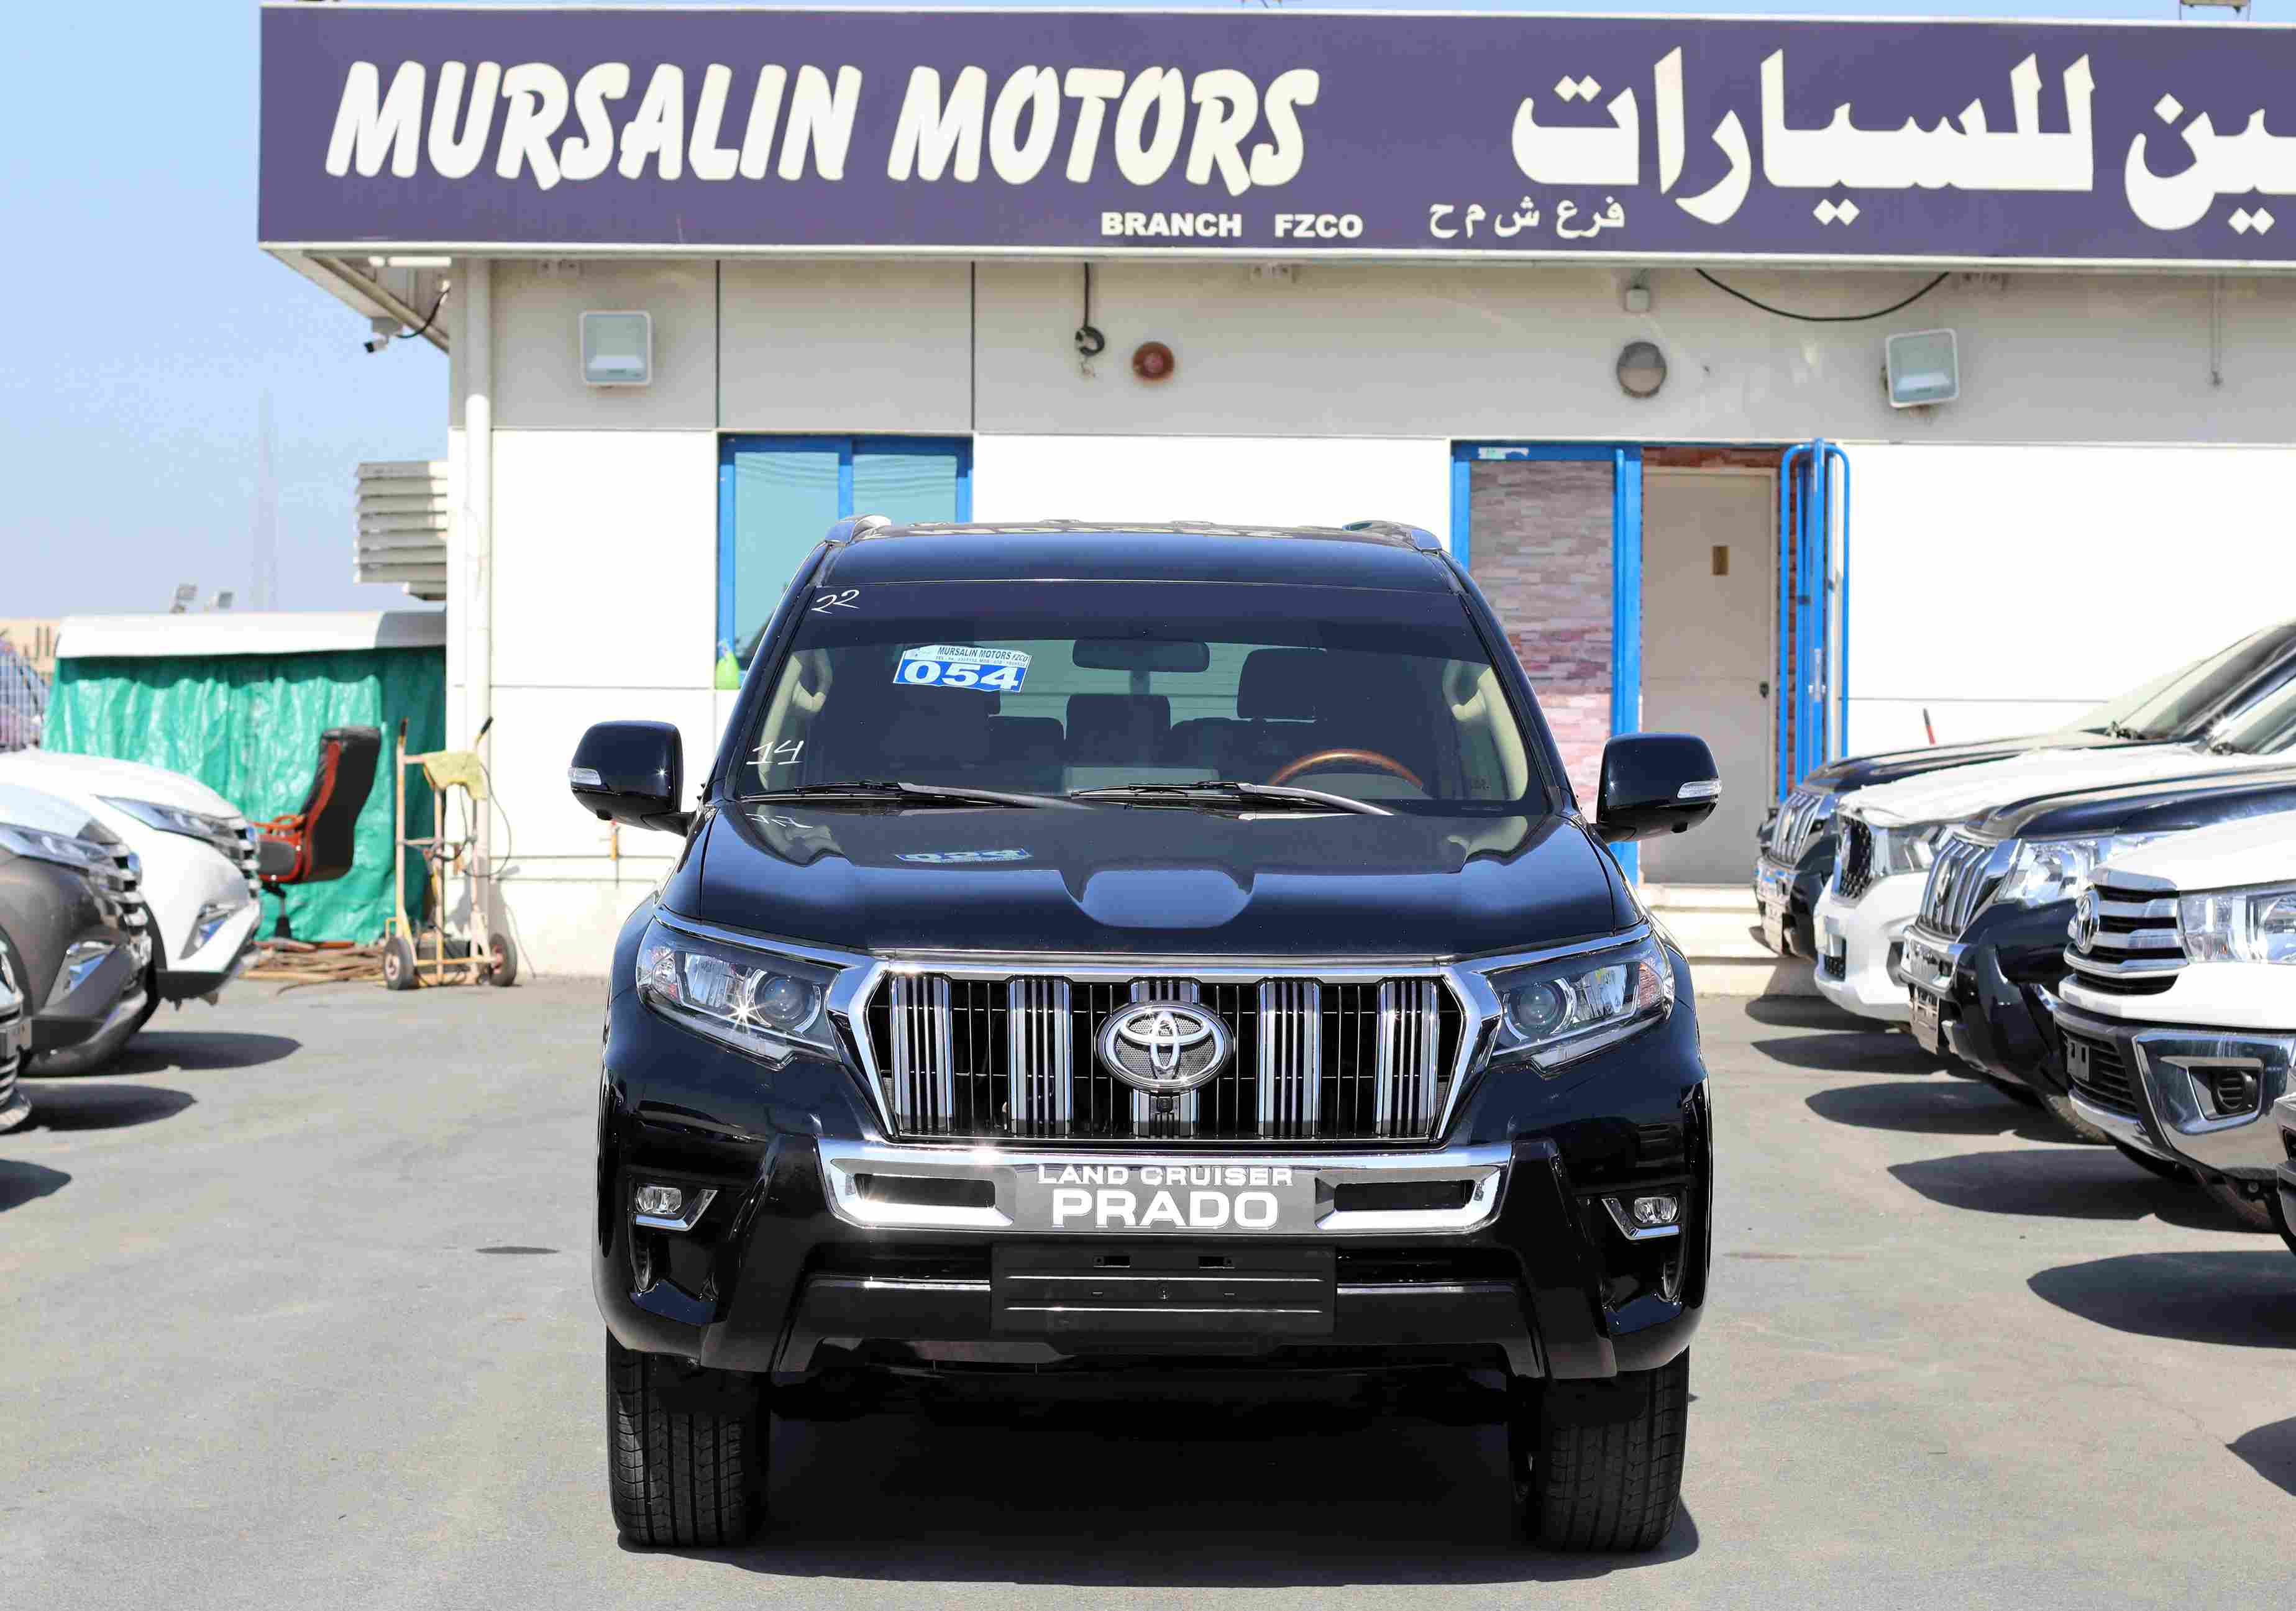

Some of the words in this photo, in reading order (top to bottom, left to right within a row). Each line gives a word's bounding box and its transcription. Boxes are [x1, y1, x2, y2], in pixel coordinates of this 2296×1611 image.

[326, 61, 862, 191] MURSALIN
[887, 64, 1320, 196] MOTORS
[1511, 47, 2095, 226] للسيارات
[2124, 93, 2296, 235] ين
[1101, 212, 1242, 237] BRANCH
[1274, 214, 1363, 238] FZCO
[1555, 196, 1625, 239] فرع
[811, 589, 860, 614] 22
[937, 646, 978, 657] MURSALIN
[979, 649, 1012, 660] MOTORS
[904, 660, 1020, 690] 054
[1038, 1164, 1129, 1185] LAND
[1140, 1166, 1294, 1187] CRUISER
[1051, 1189, 1279, 1230] PRADO
